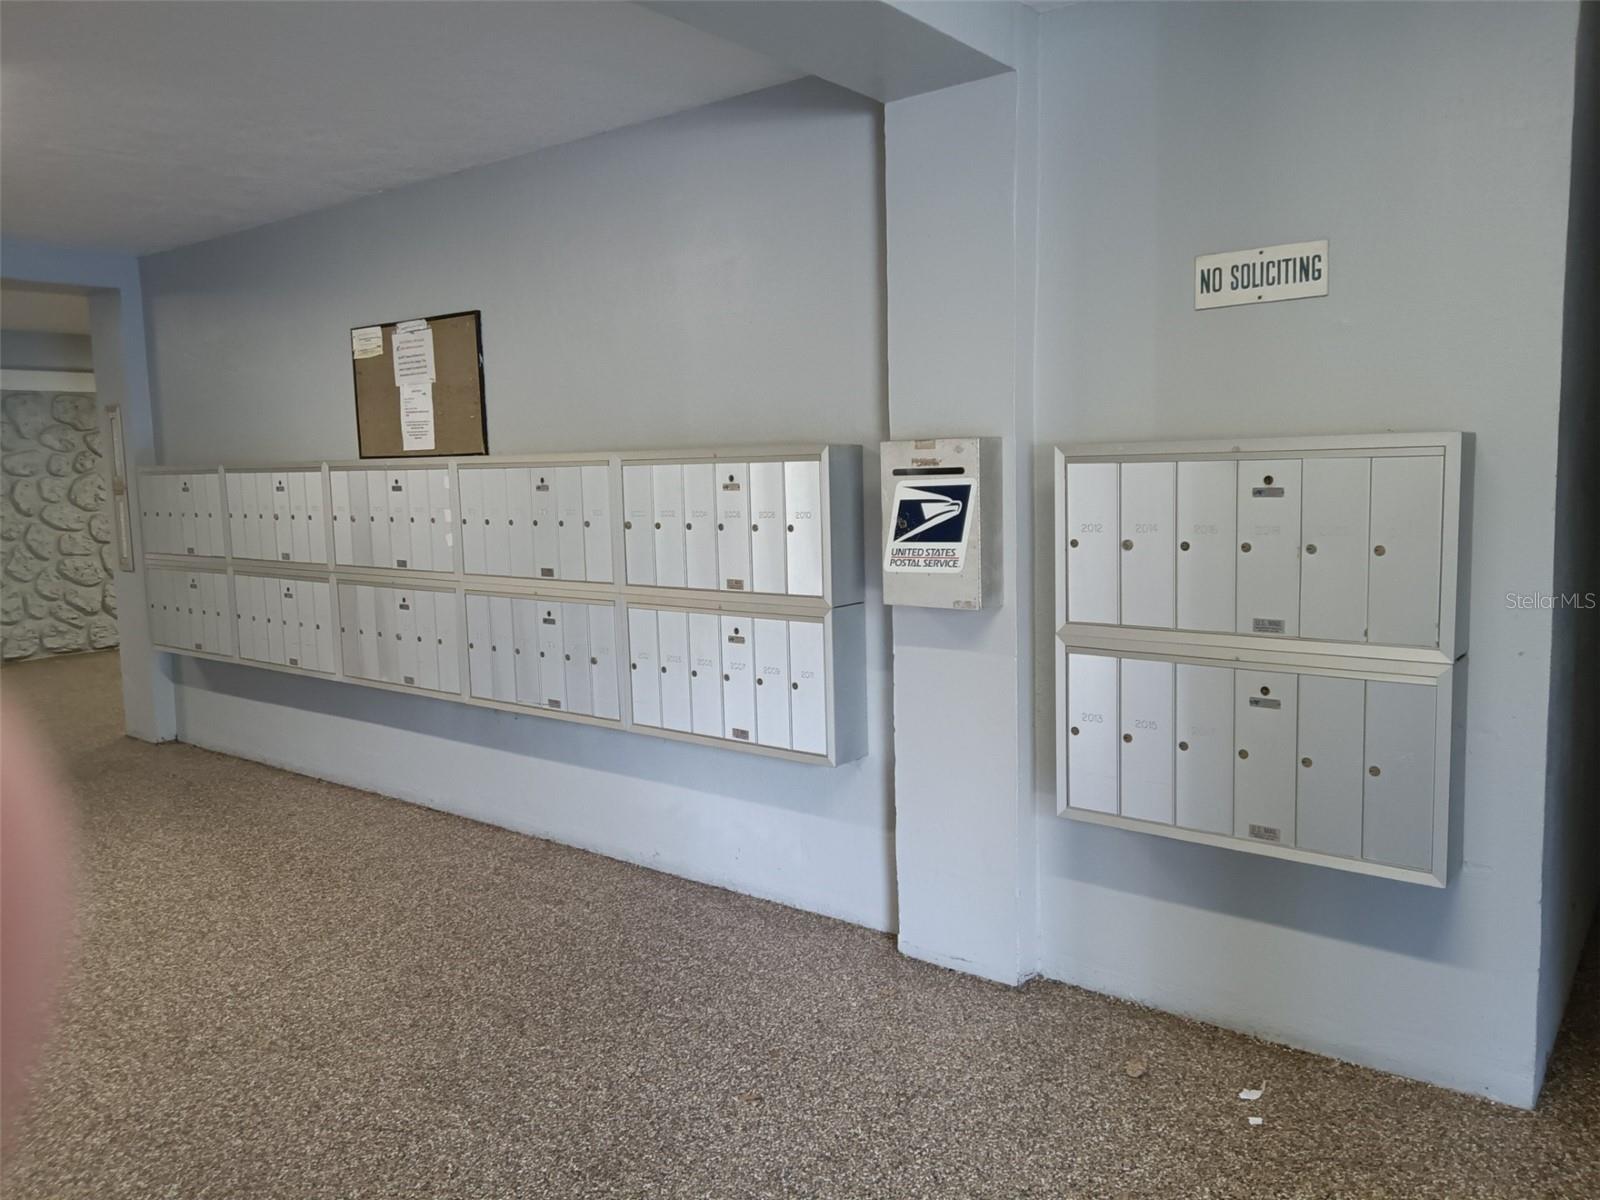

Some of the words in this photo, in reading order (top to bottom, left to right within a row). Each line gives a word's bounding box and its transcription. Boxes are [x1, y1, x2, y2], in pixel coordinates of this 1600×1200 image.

[1200, 267, 1222, 294] NO
[1230, 254, 1322, 291] SOLICITING
[794, 511, 812, 520] 2010
[1080, 523, 1104, 534] 2012
[1135, 523, 1160, 534] 2014
[891, 548, 924, 557] UNITED
[925, 548, 957, 557] STATES
[889, 559, 922, 567] POSTAL
[923, 560, 960, 568] SERVICE
[1081, 712, 1104, 724] 2013
[1135, 719, 1159, 731] 2015
